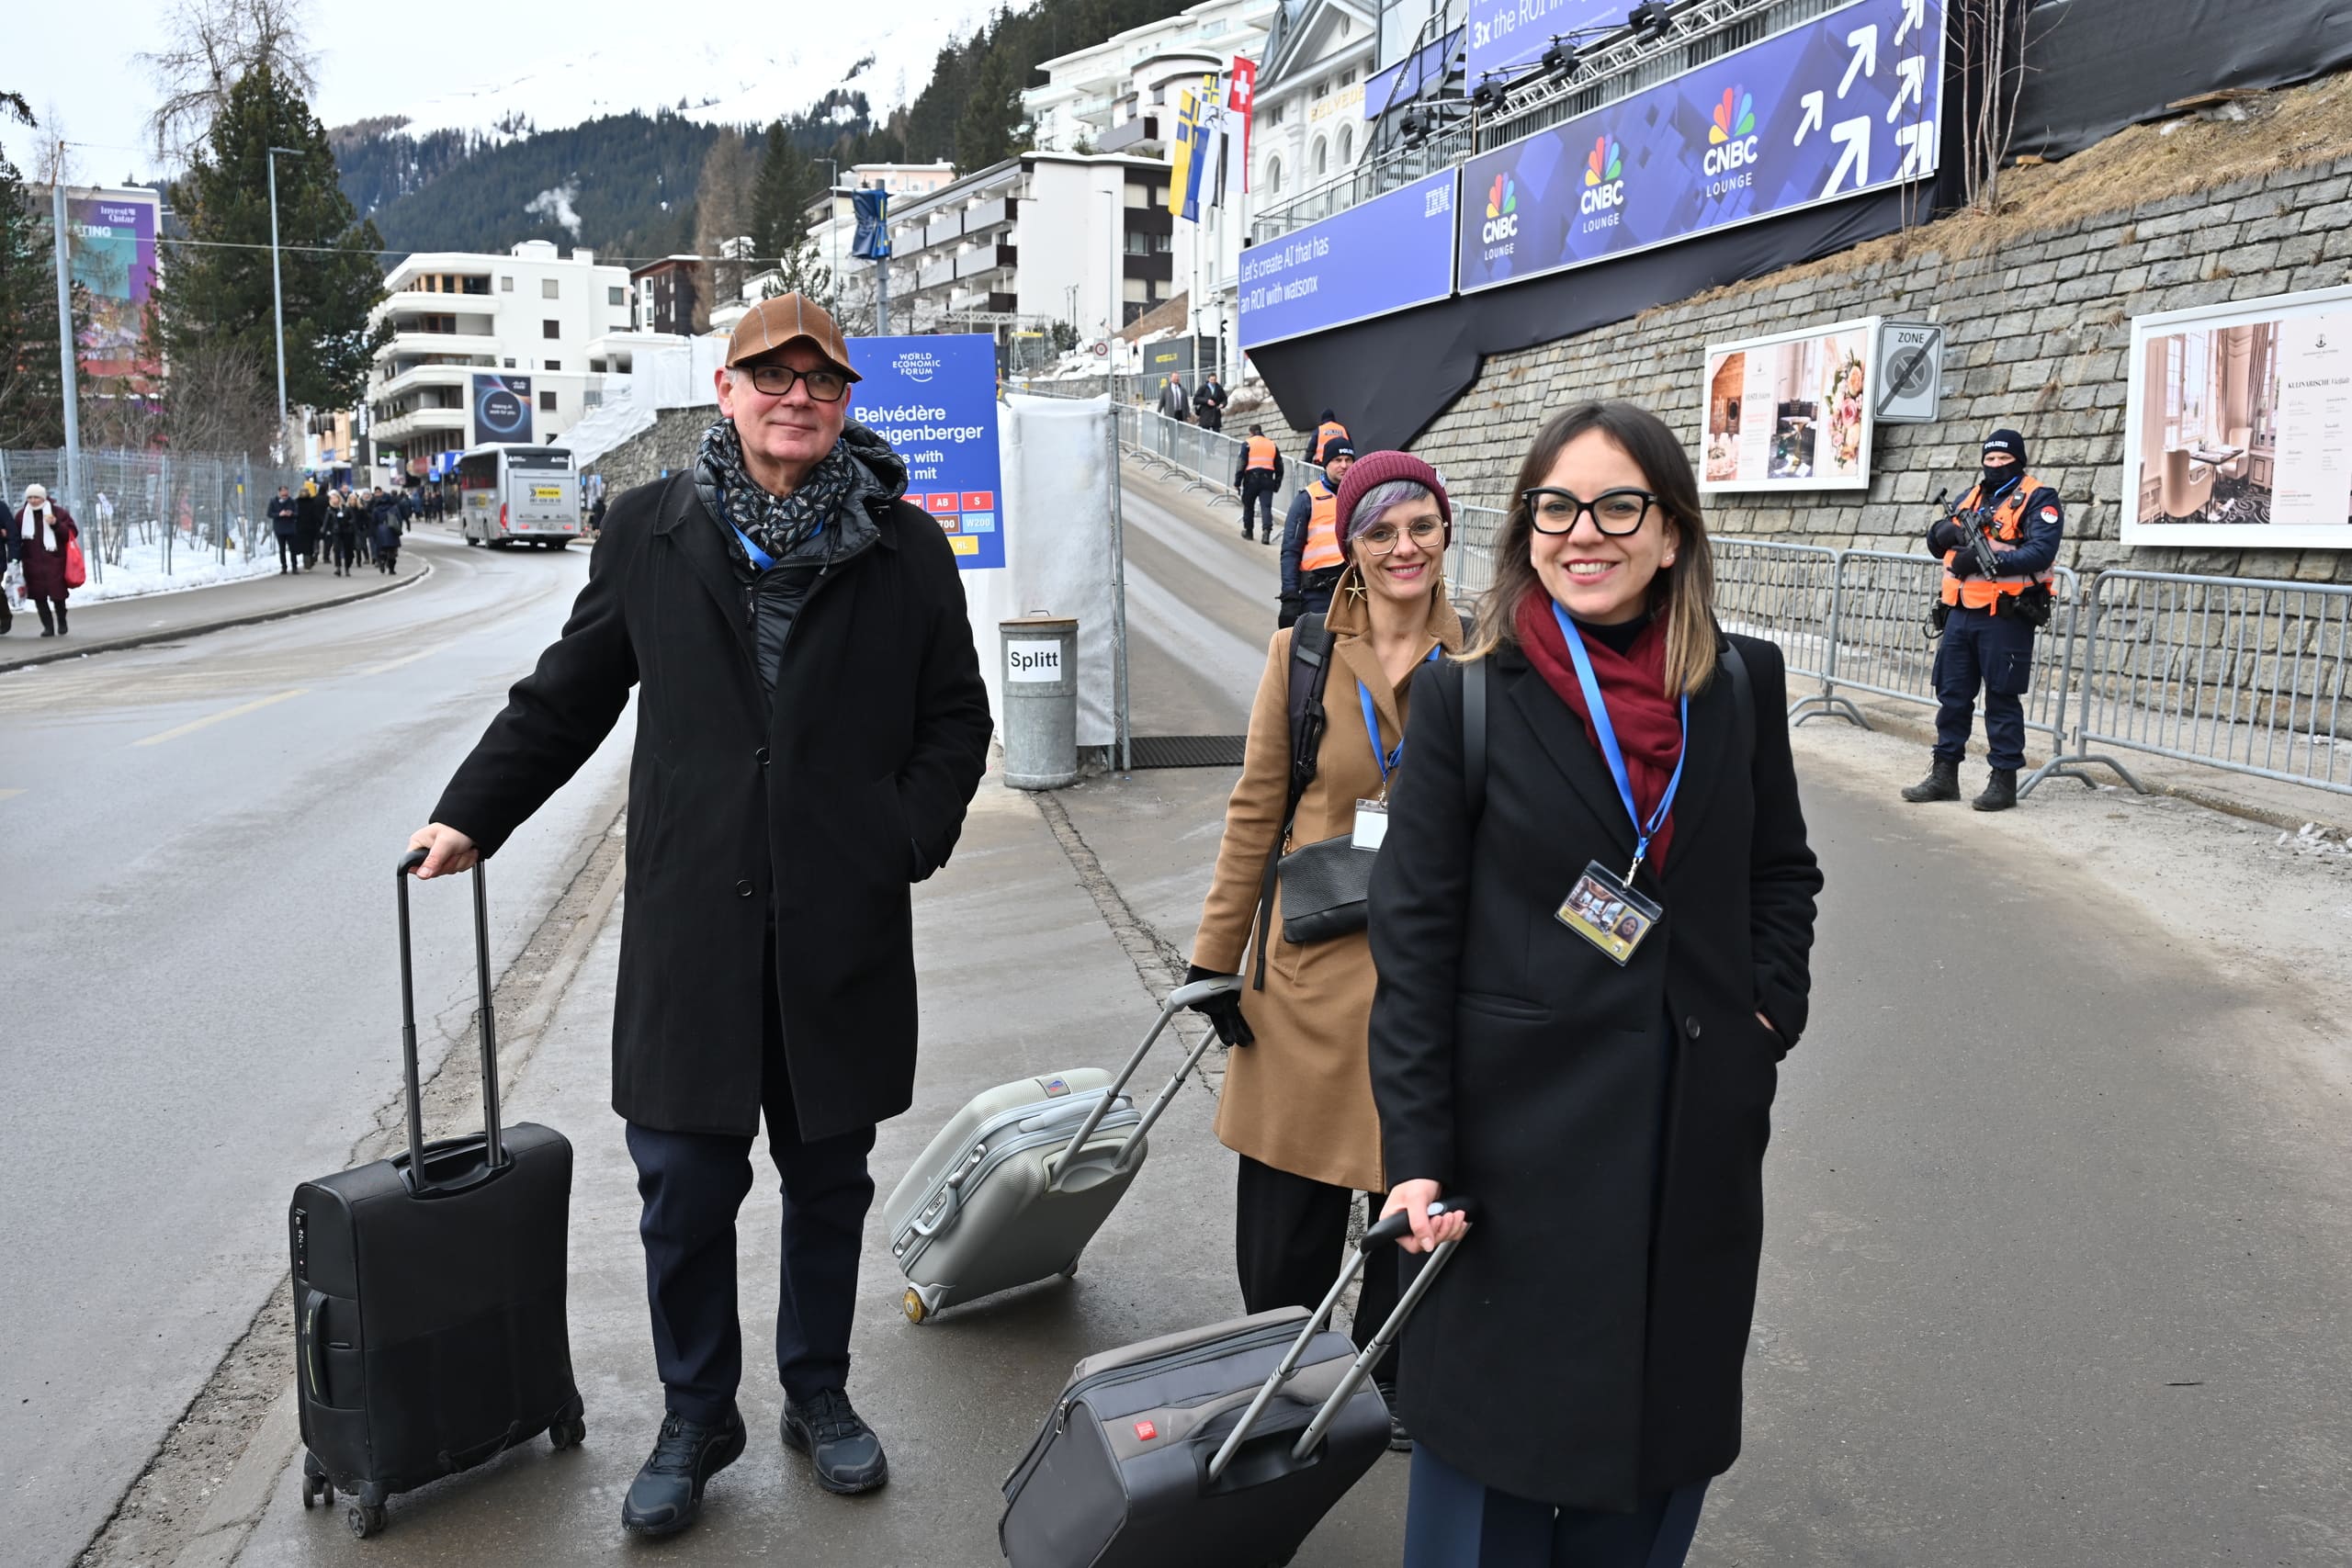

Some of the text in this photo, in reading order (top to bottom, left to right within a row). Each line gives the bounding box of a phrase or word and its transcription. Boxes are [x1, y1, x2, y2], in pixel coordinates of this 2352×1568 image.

[1474, 21, 1491, 49] 3x
[1494, 7, 1515, 39] the
[1703, 135, 1758, 176] CNBC
[1706, 172, 1752, 197] LOUNGE
[1425, 184, 1451, 218] IBM
[1580, 180, 1623, 215] CNBC
[1483, 213, 1518, 243] CNBC
[1583, 213, 1620, 233] LOUNGE
[1241, 235, 1329, 283] Let's create AI that has
[1484, 243, 1514, 261] LOUNGE
[1240, 275, 1318, 314] an ROI with watsonx
[1897, 332, 1925, 344] ZONE
[892, 359, 941, 368] ECONOMIC
[899, 352, 933, 360] WORLD
[854, 404, 946, 423] Belvédère
[871, 424, 984, 446] eigenberger
[914, 450, 944, 463] with
[914, 467, 937, 479] mit
[936, 498, 949, 507] AB
[974, 497, 980, 505] S
[938, 519, 955, 528] 700
[966, 519, 990, 527] W200
[1011, 651, 1058, 671] Splitt
